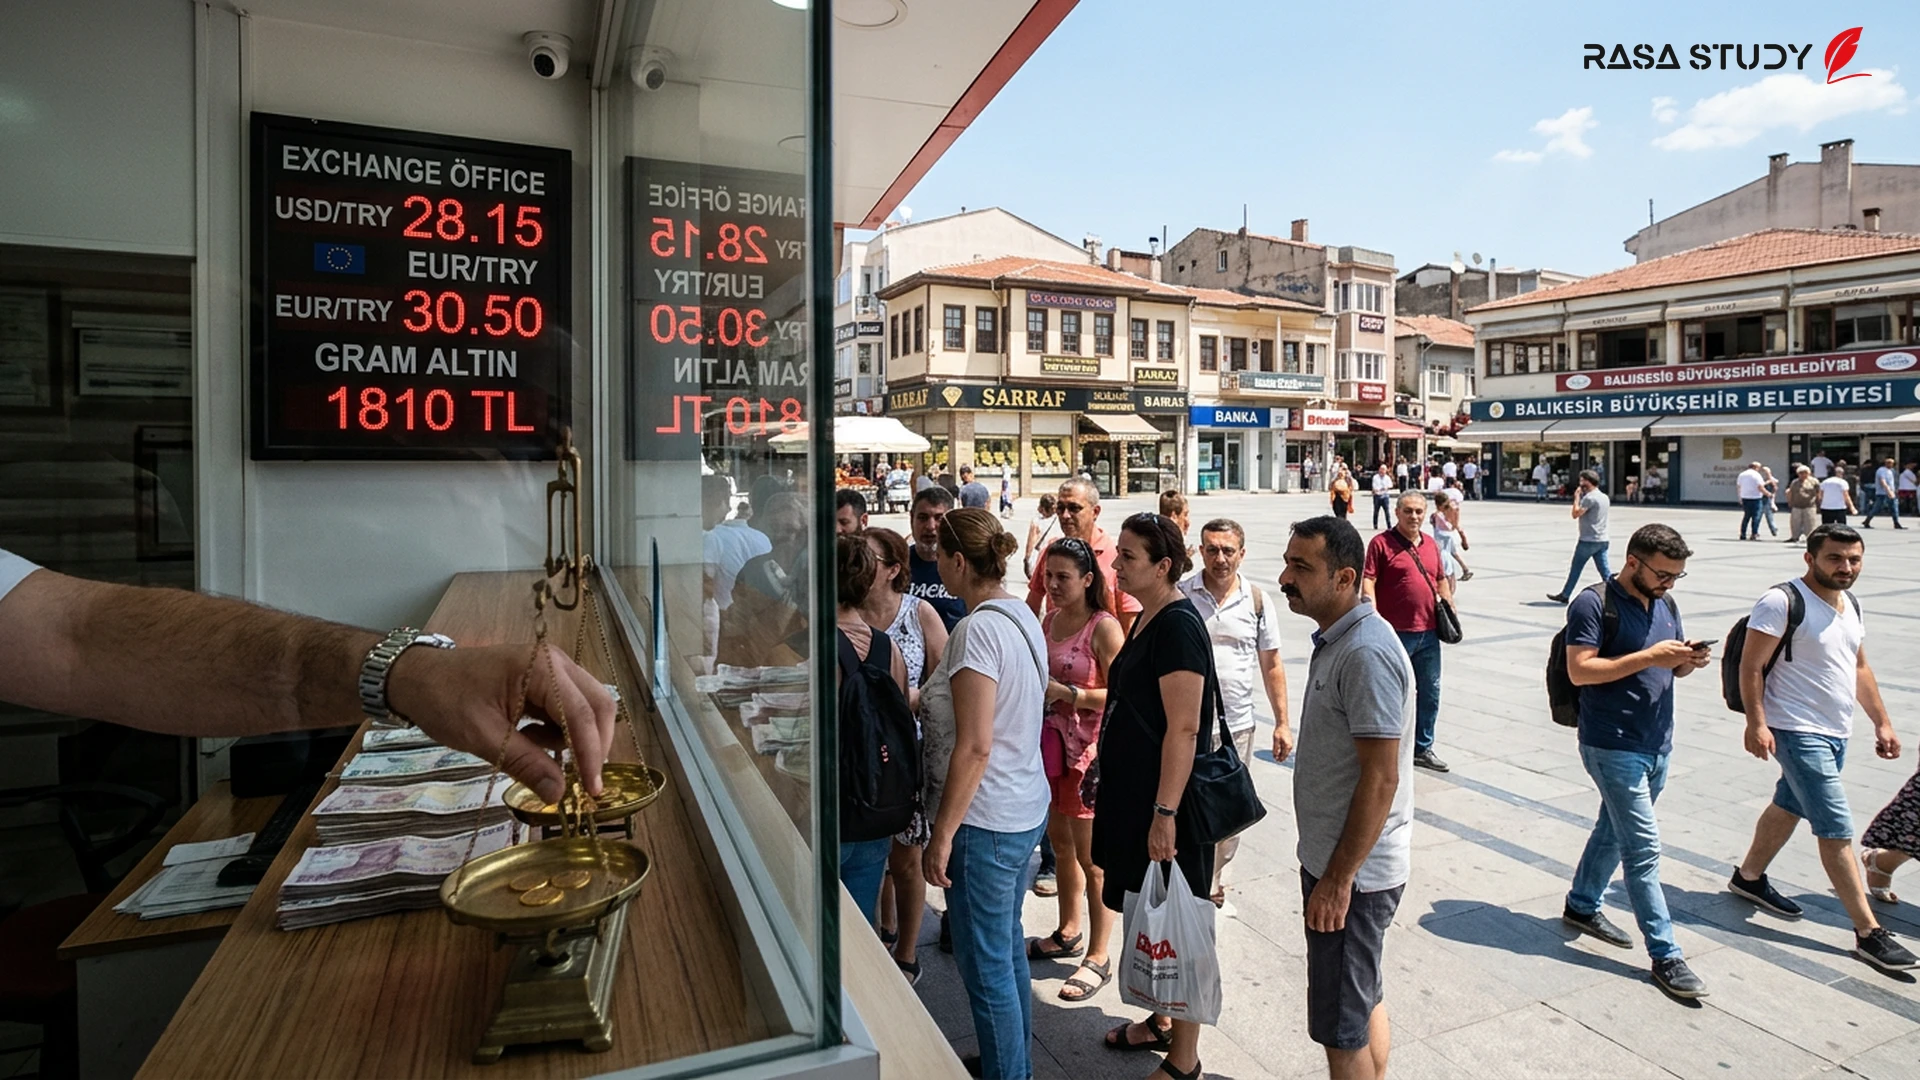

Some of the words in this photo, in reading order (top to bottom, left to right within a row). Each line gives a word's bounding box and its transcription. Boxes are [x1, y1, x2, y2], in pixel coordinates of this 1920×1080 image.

[282, 144, 442, 186] EXCHANGE
[450, 158, 546, 196] ÖFFICE
[275, 195, 394, 228] USD/TRY
[402, 195, 543, 248] 28.15
[408, 250, 539, 285] EUR/TRY
[275, 294, 394, 322] EUR/TRY
[402, 289, 543, 338] 30.50
[315, 342, 417, 375] GRAM
[426, 347, 518, 378] ALTIN
[327, 386, 455, 432] 1810
[471, 390, 535, 432] TL
[982, 387, 1066, 408] SARRAF
[1515, 396, 1604, 417] BALIKESİR
[1610, 390, 1738, 413] BÜYÜKŞEHİR
[1747, 382, 1893, 407] BELEDİYESİ
[1215, 410, 1258, 424] BANKA
